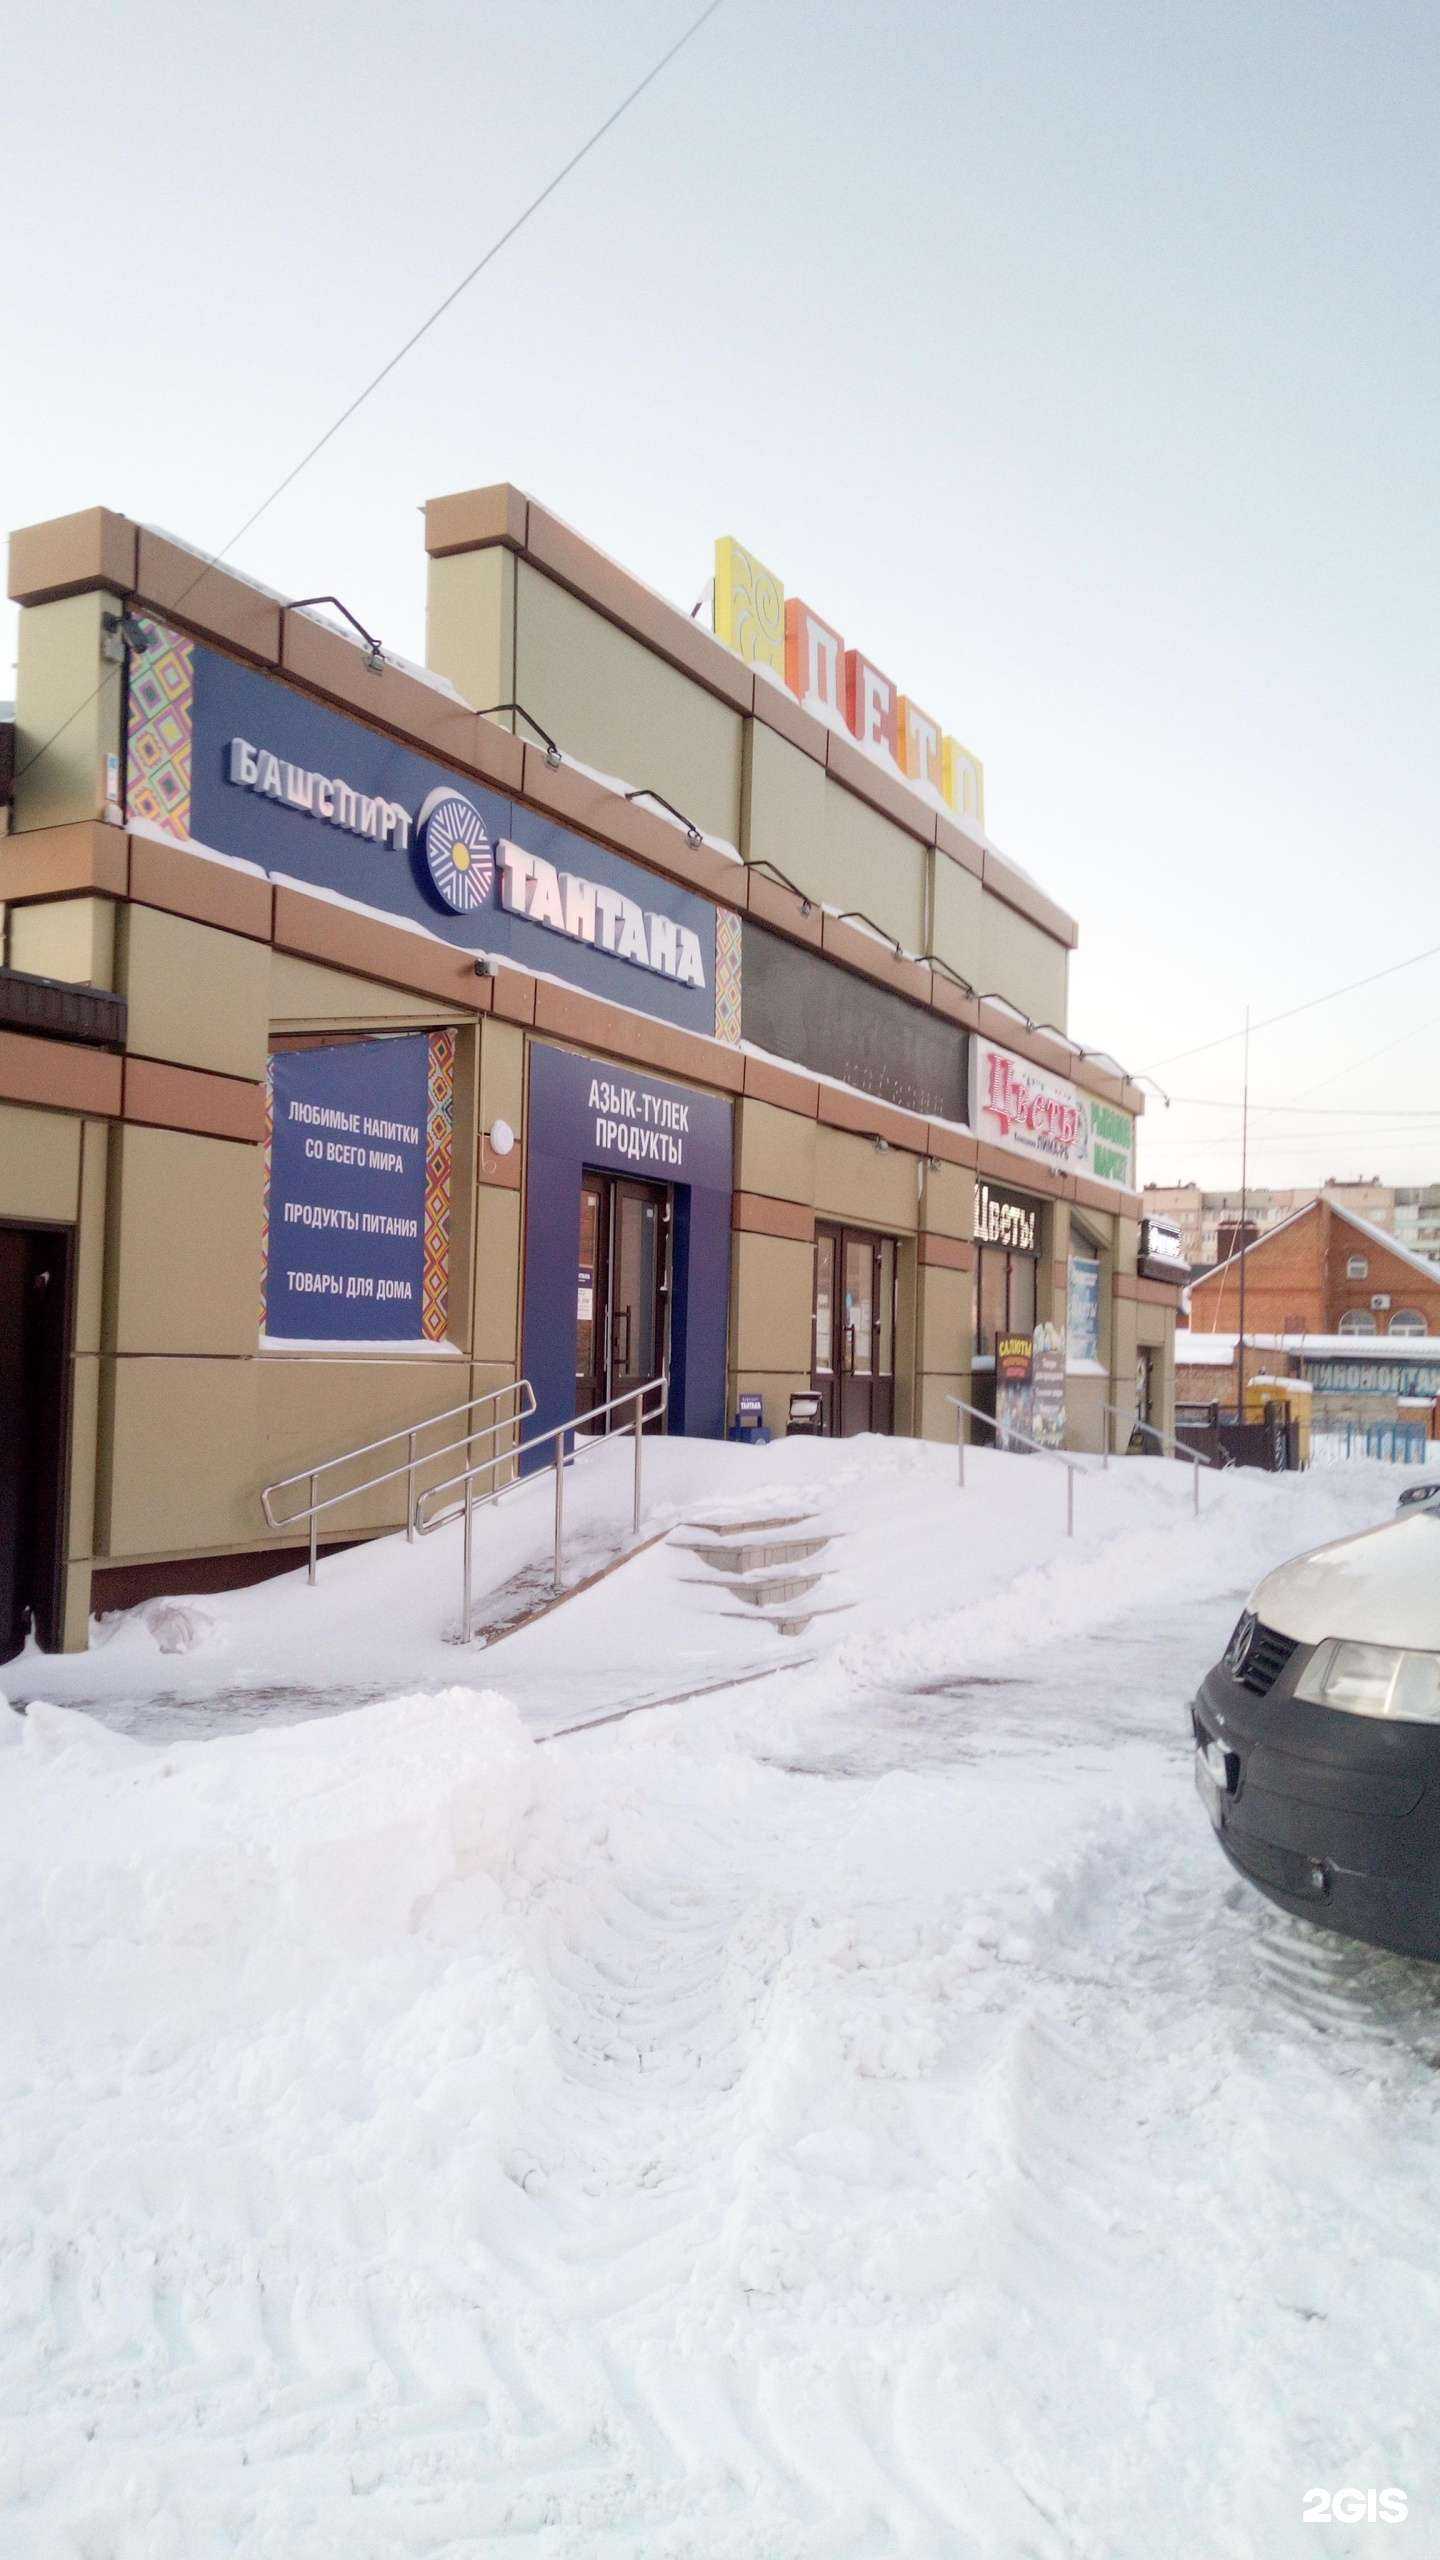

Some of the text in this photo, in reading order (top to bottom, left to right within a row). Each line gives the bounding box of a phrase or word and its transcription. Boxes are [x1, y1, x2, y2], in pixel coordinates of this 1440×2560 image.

[230, 737, 413, 851] БАШСПИРТ
[496, 838, 706, 989] ТАНТАНА
[288, 1101, 419, 1145] ЛЮБИМЫЕ НАПИТКИ
[596, 1117, 682, 1166] ПРОДУКТЫ
[305, 1138, 404, 1174] СО ВСЕГО МИРА
[284, 1202, 417, 1238] ПРОДУКТЫ ПИТАНИЯ
[287, 1271, 412, 1300] ТОВАРЫ ДЛЯ ДОМА
[999, 1338, 1032, 1358] САЛЮТЫ
